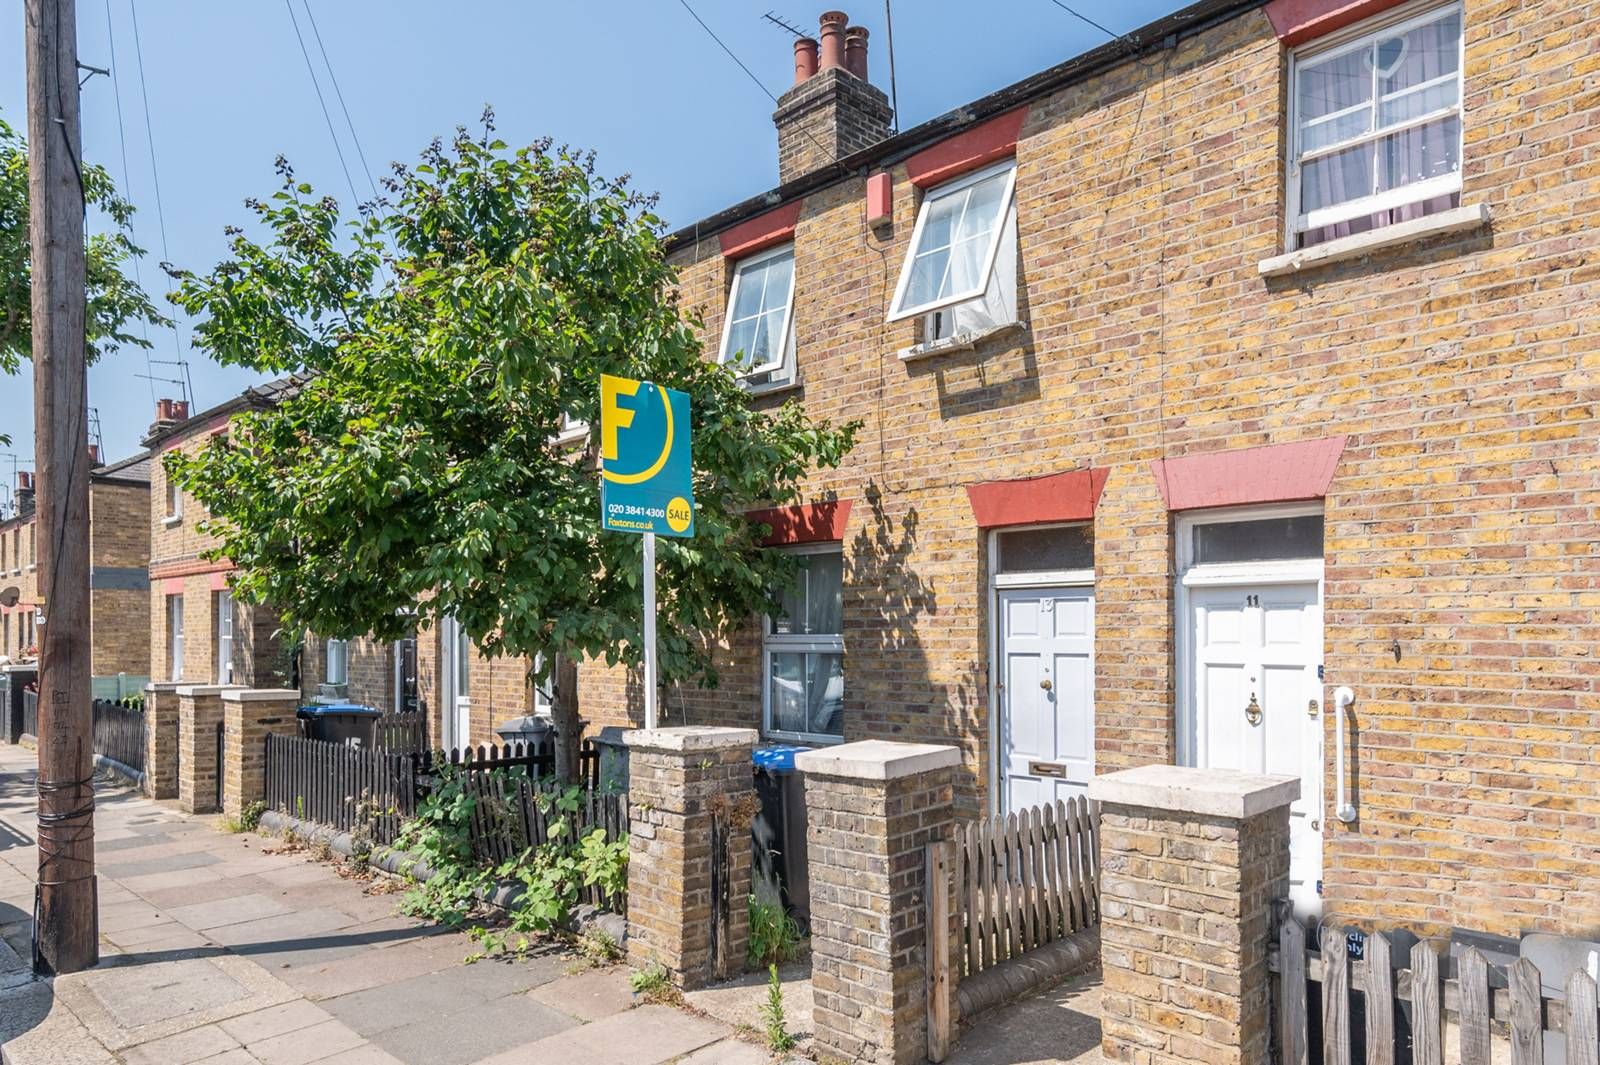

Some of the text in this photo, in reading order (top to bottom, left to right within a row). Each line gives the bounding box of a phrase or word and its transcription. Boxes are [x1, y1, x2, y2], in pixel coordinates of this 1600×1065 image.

[600, 373, 641, 460] F
[608, 503, 665, 518] 020 3841 4300
[668, 508, 690, 521] SALE
[608, 517, 653, 530] Foxtons.co.uk
[1040, 598, 1054, 613] 13
[1246, 594, 1259, 606] 11
